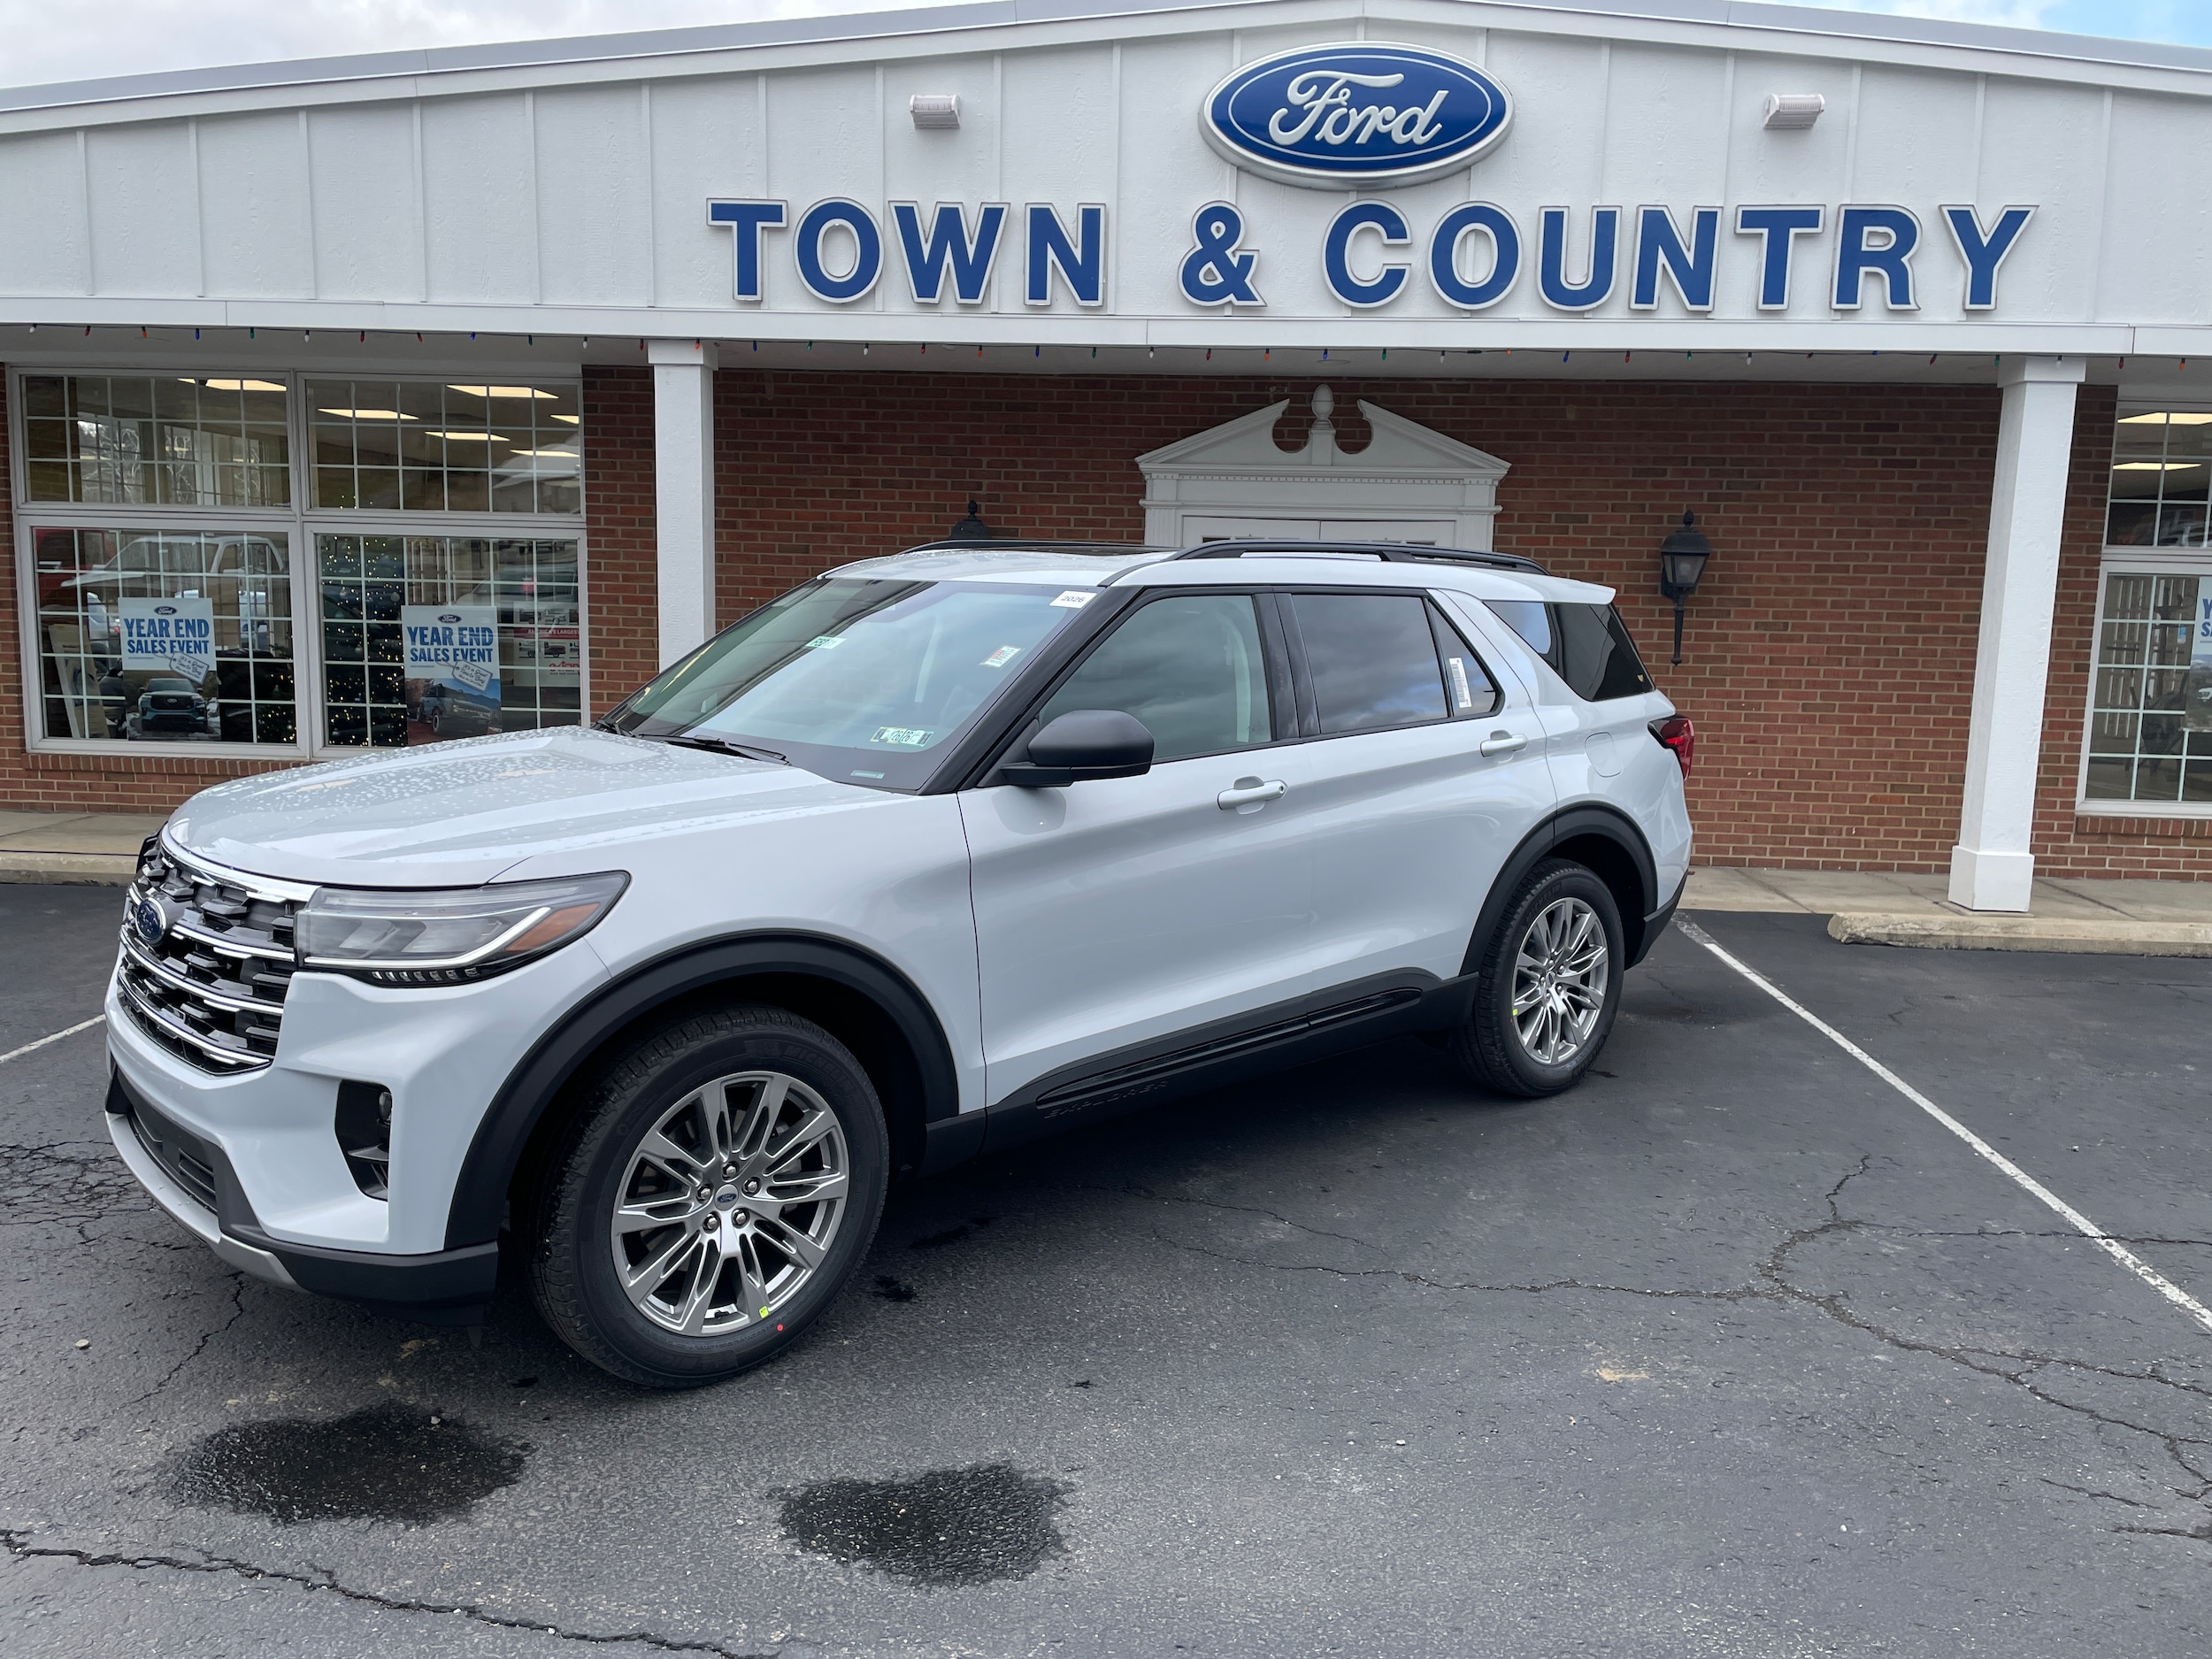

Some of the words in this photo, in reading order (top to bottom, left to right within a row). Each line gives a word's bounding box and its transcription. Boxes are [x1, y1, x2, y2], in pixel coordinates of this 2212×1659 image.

[1268, 69, 1449, 148] Ford
[707, 197, 1107, 307] TOWN
[1178, 200, 1267, 308] &
[1322, 199, 2039, 311] COUNTRY
[123, 618, 170, 638] YEAR
[174, 618, 210, 638] END
[406, 626, 454, 646] YEAR
[457, 626, 494, 646] END
[127, 640, 166, 654] SALES
[169, 640, 210, 654] EVENT
[410, 648, 449, 662] SALES
[453, 648, 493, 662] EVENT
[1043, 1080, 1169, 1119] EXPLORER
